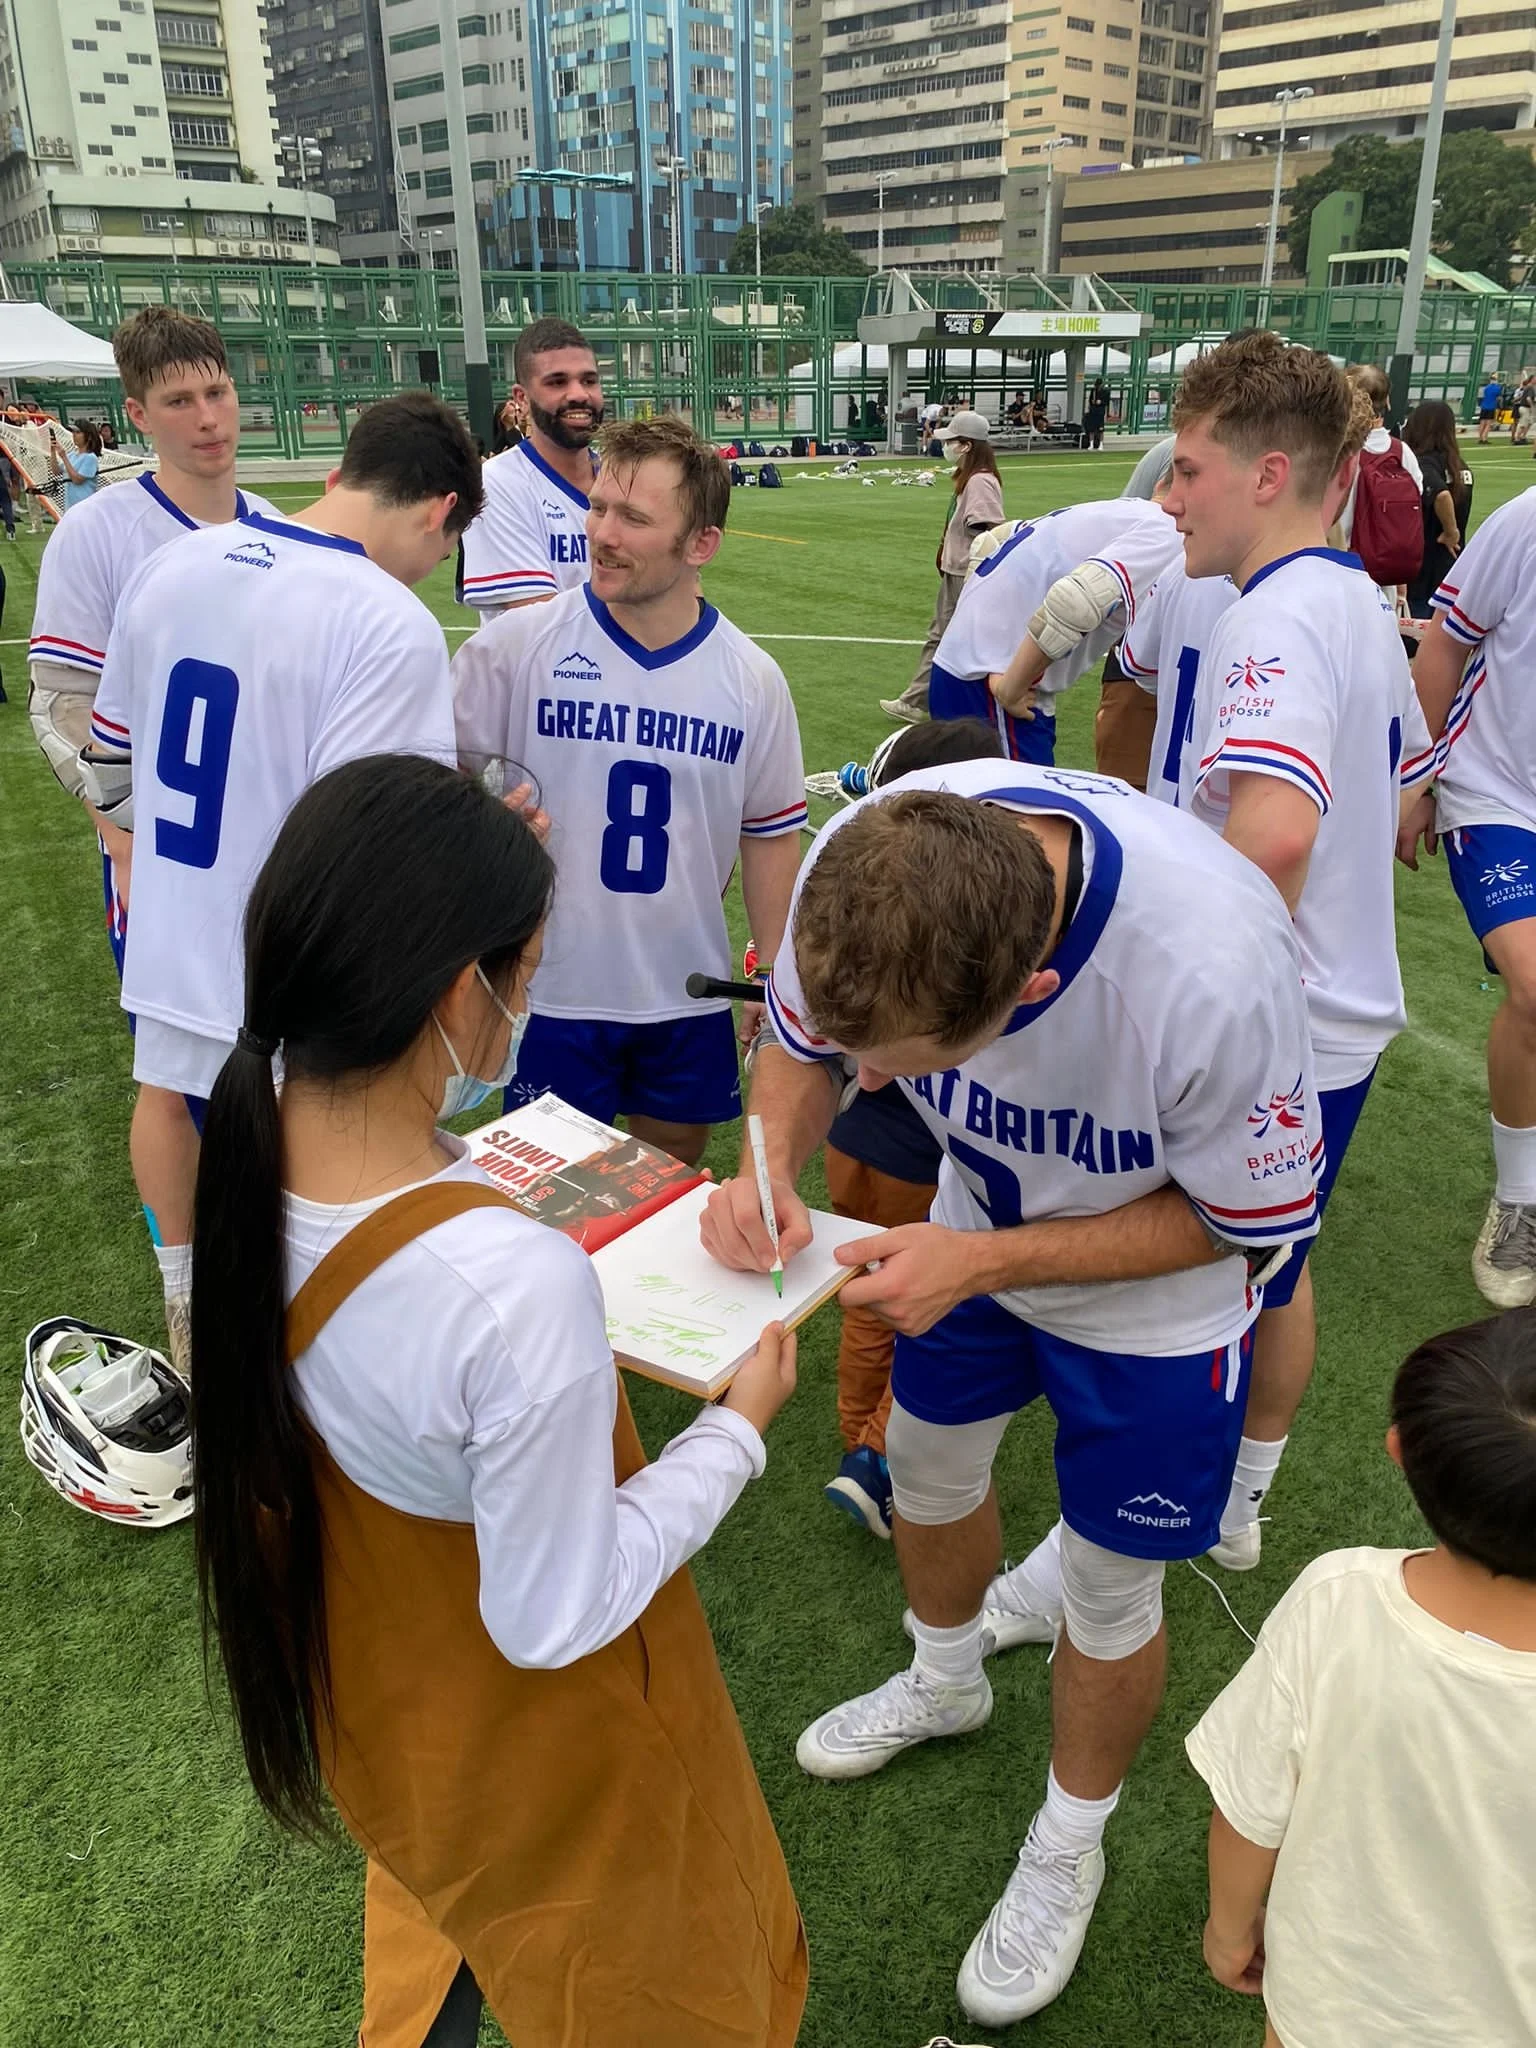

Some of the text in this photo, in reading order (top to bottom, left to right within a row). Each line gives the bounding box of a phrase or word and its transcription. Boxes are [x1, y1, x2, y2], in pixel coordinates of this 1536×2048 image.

[1068, 317, 1101, 332] HOME
[223, 552, 273, 570] PIONEER
[553, 669, 602, 681] PIONEER
[537, 697, 745, 765] GREAT BRITAIN
[155, 657, 240, 870] 9
[600, 759, 672, 895] 8
[1485, 883, 1534, 902] BRITISH
[1487, 889, 1535, 908] LACROSSE
[965, 1079, 1155, 1174] BRITAIN
[482, 1129, 569, 1173] LIMITS
[472, 1151, 540, 1188] YOUR
[1116, 1507, 1192, 1528] PIONEER
